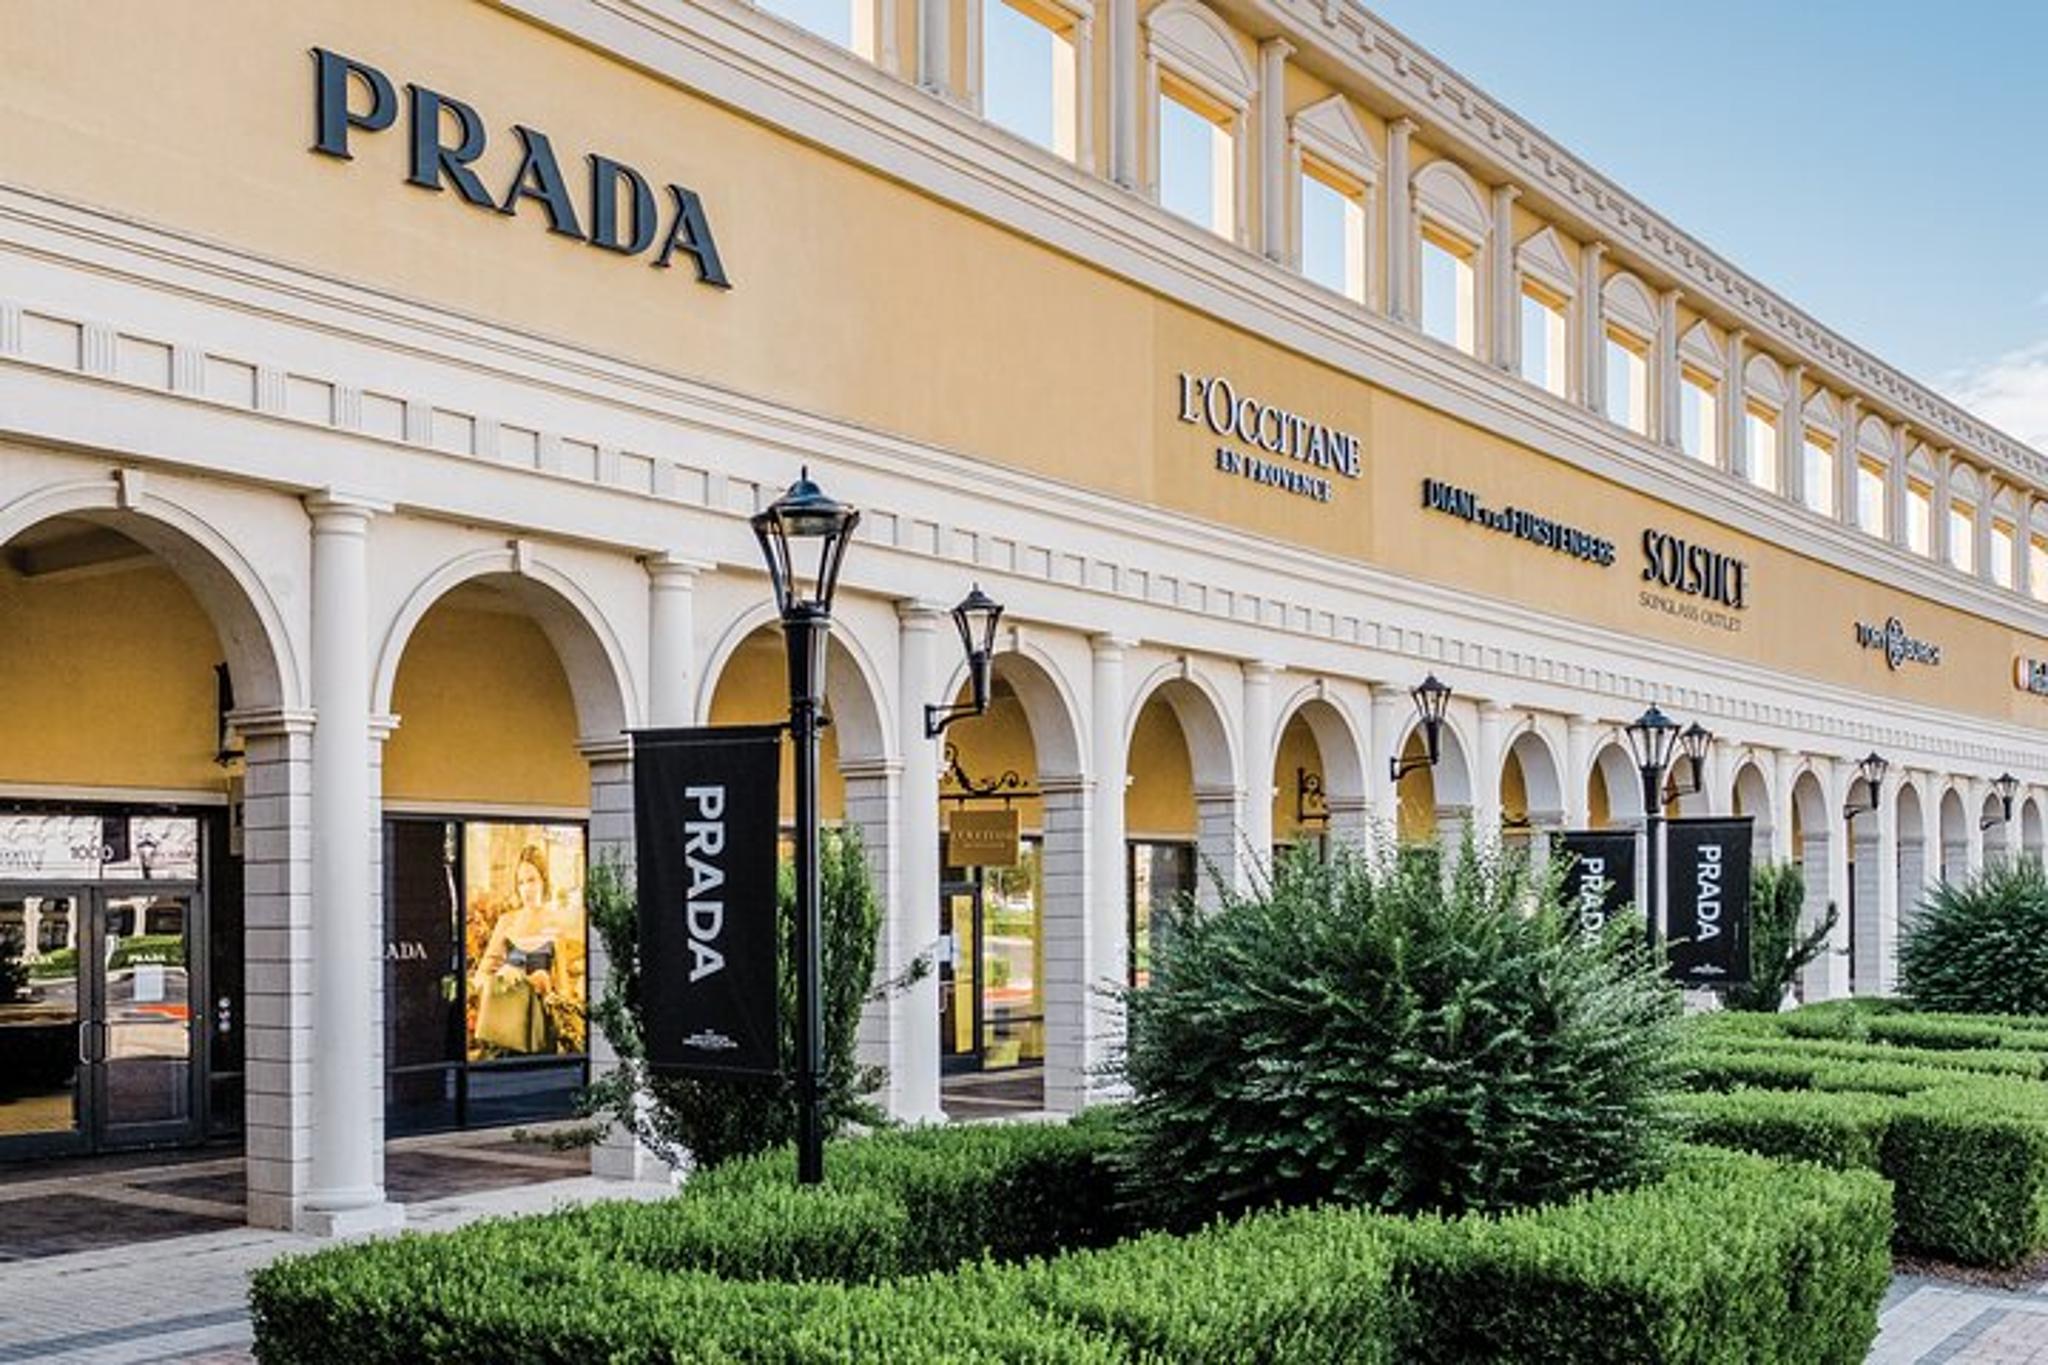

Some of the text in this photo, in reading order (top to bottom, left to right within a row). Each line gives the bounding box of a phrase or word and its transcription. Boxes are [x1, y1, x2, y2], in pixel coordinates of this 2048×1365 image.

[308, 46, 733, 290] PRADA
[1179, 372, 1363, 480] L'OCCITANE
[1215, 447, 1334, 502] EN PROVENCE
[1642, 529, 1750, 610] SOLSTICE
[1700, 609, 1742, 632] OUTLET
[685, 785, 726, 984] PRADA
[1696, 844, 1722, 942] PRADA
[384, 941, 428, 960] ADA
